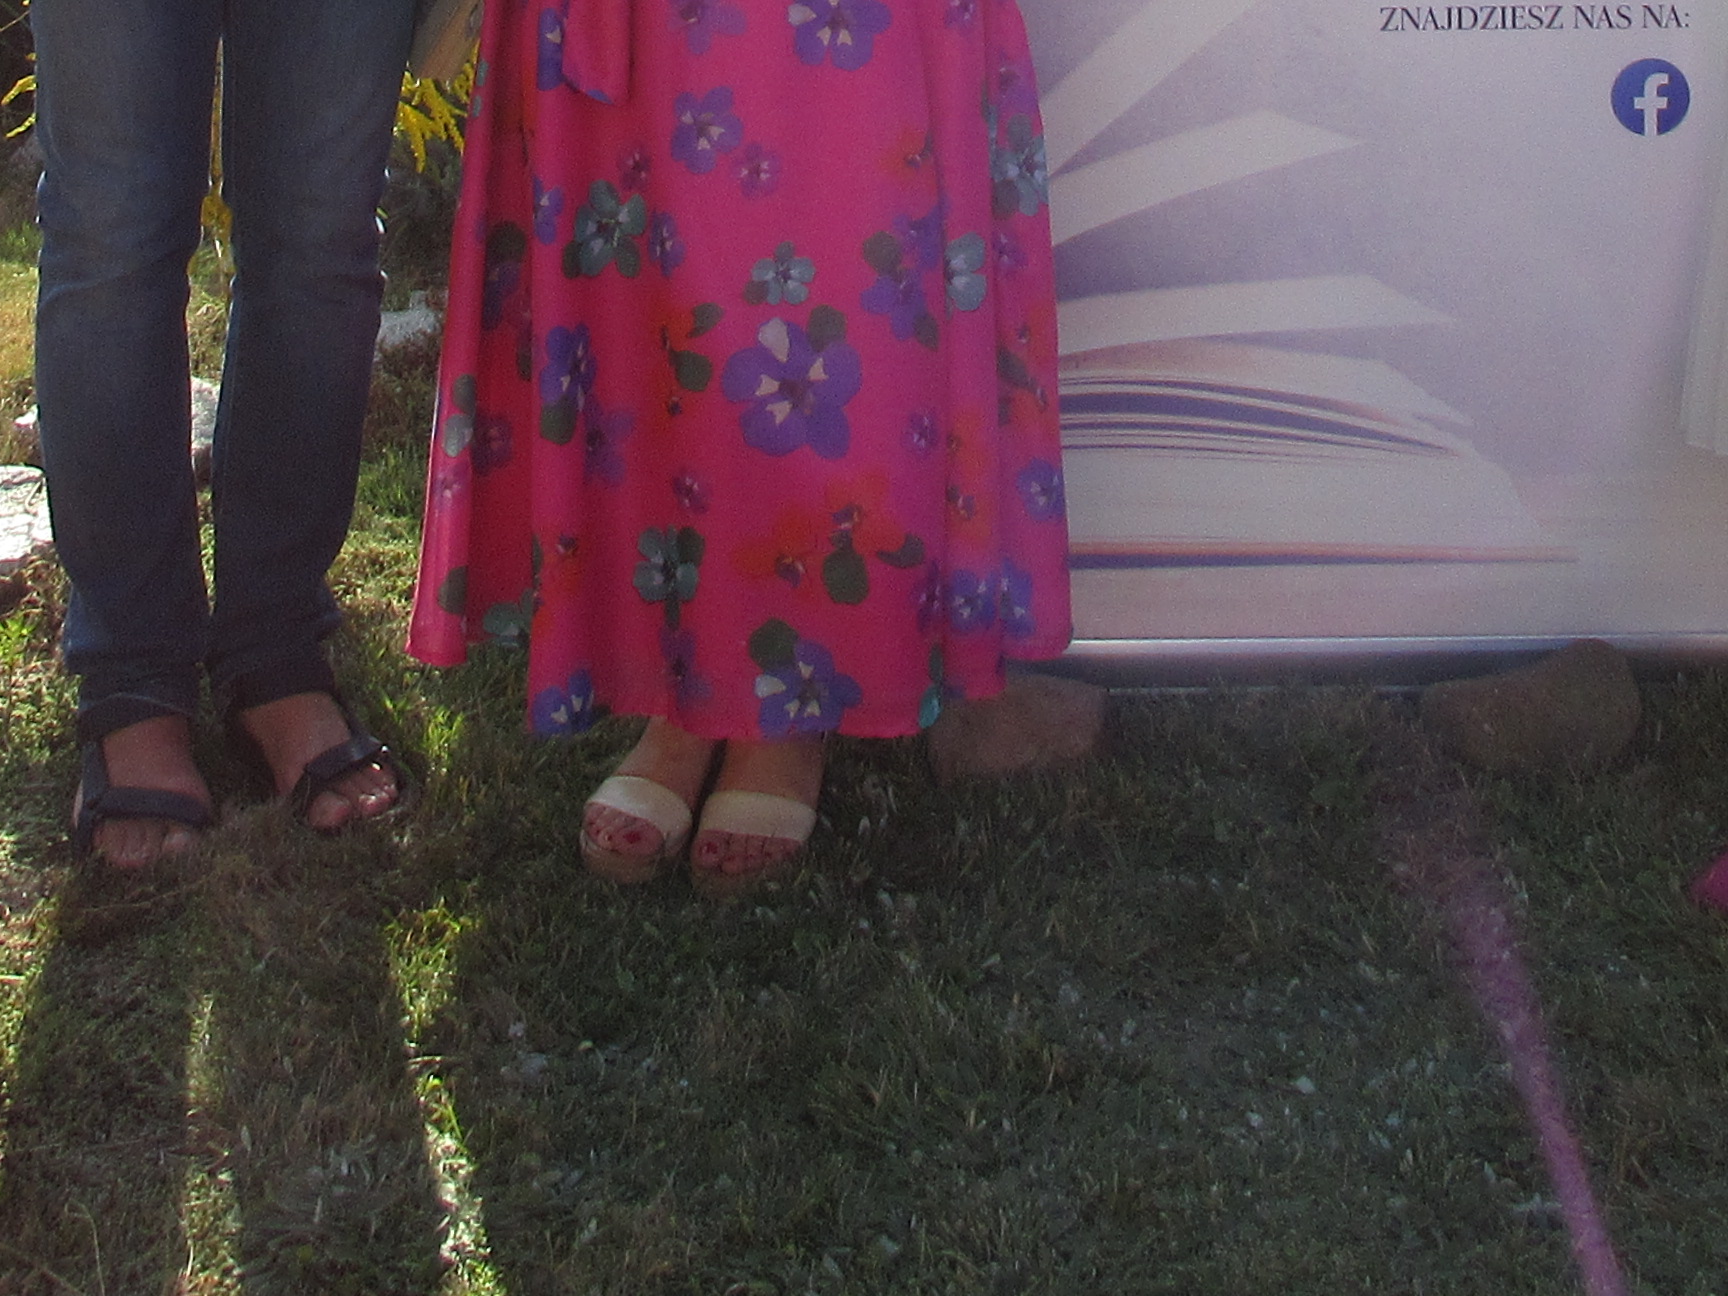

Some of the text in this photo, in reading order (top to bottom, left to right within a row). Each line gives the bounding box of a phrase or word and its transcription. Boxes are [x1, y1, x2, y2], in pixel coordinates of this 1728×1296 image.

[1379, 4, 1690, 34] ZNAJDZIESZ NAS NA:
